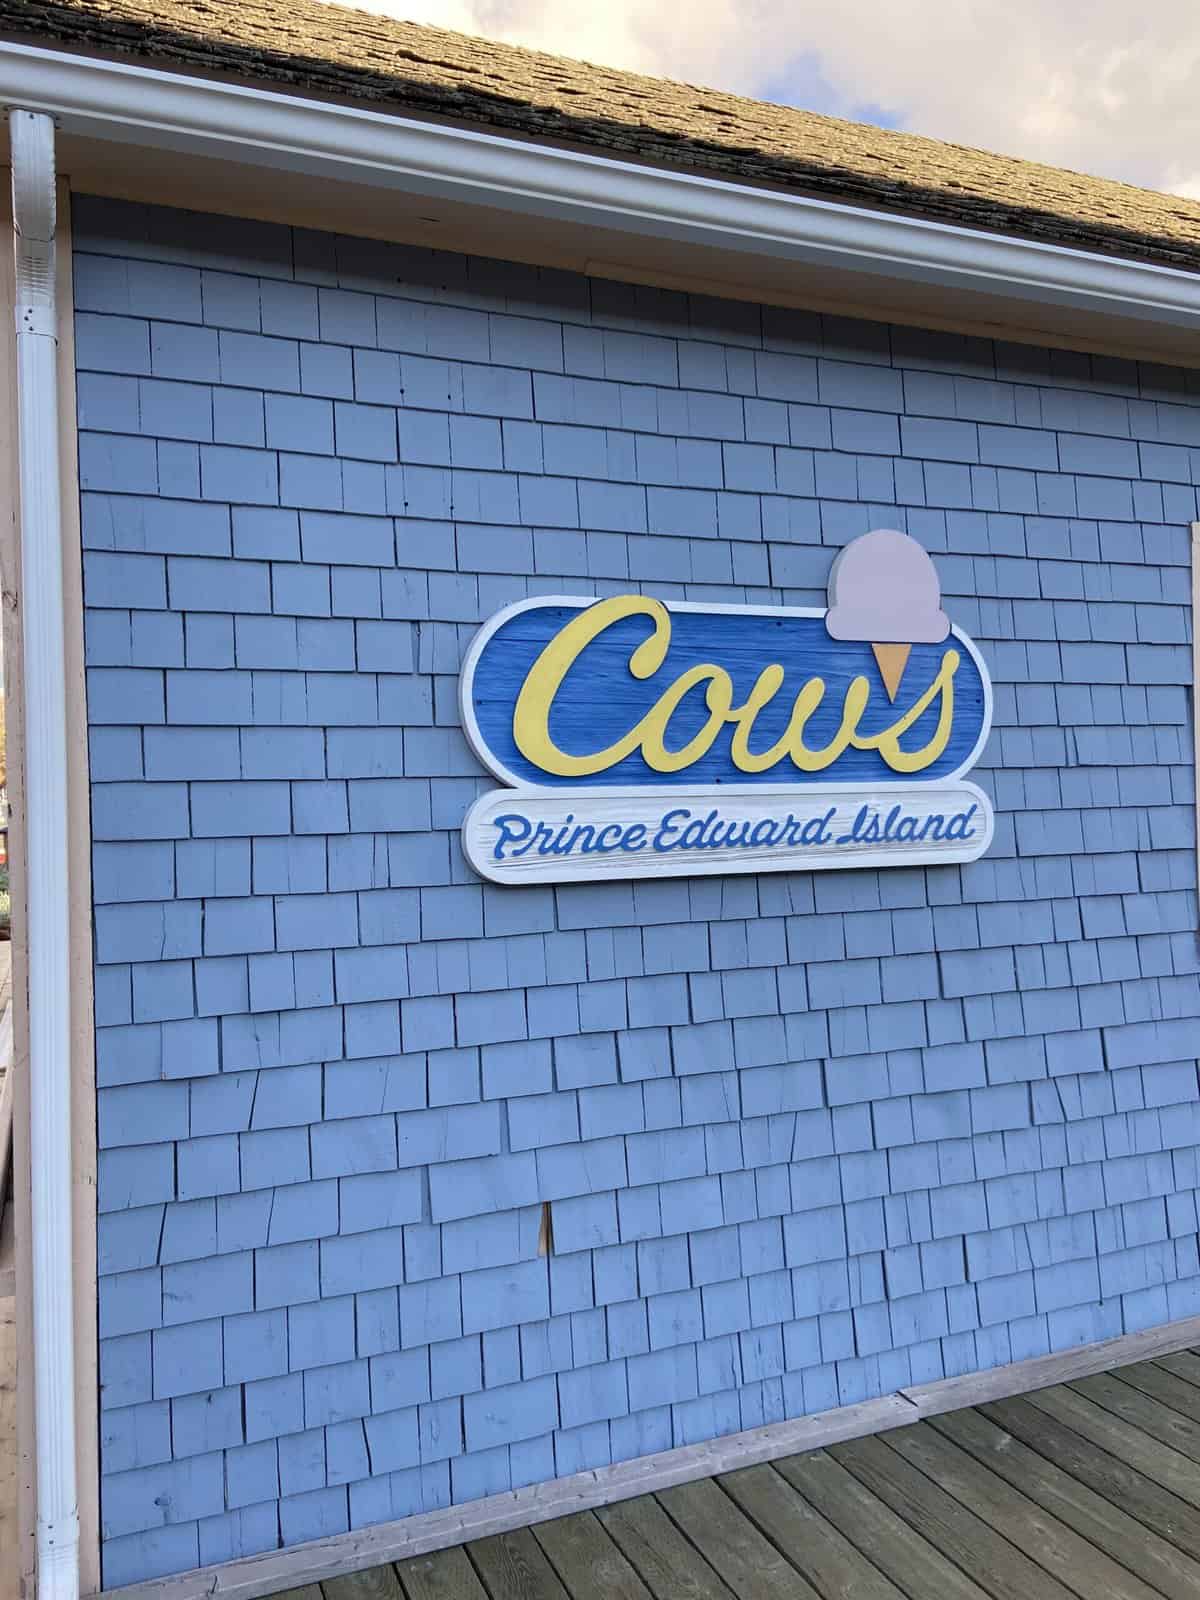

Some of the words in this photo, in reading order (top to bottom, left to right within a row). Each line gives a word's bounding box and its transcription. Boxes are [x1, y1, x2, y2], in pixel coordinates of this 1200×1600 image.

[493, 814, 648, 860] Prince
[655, 808, 838, 852] Edward
[834, 804, 978, 844] Island
